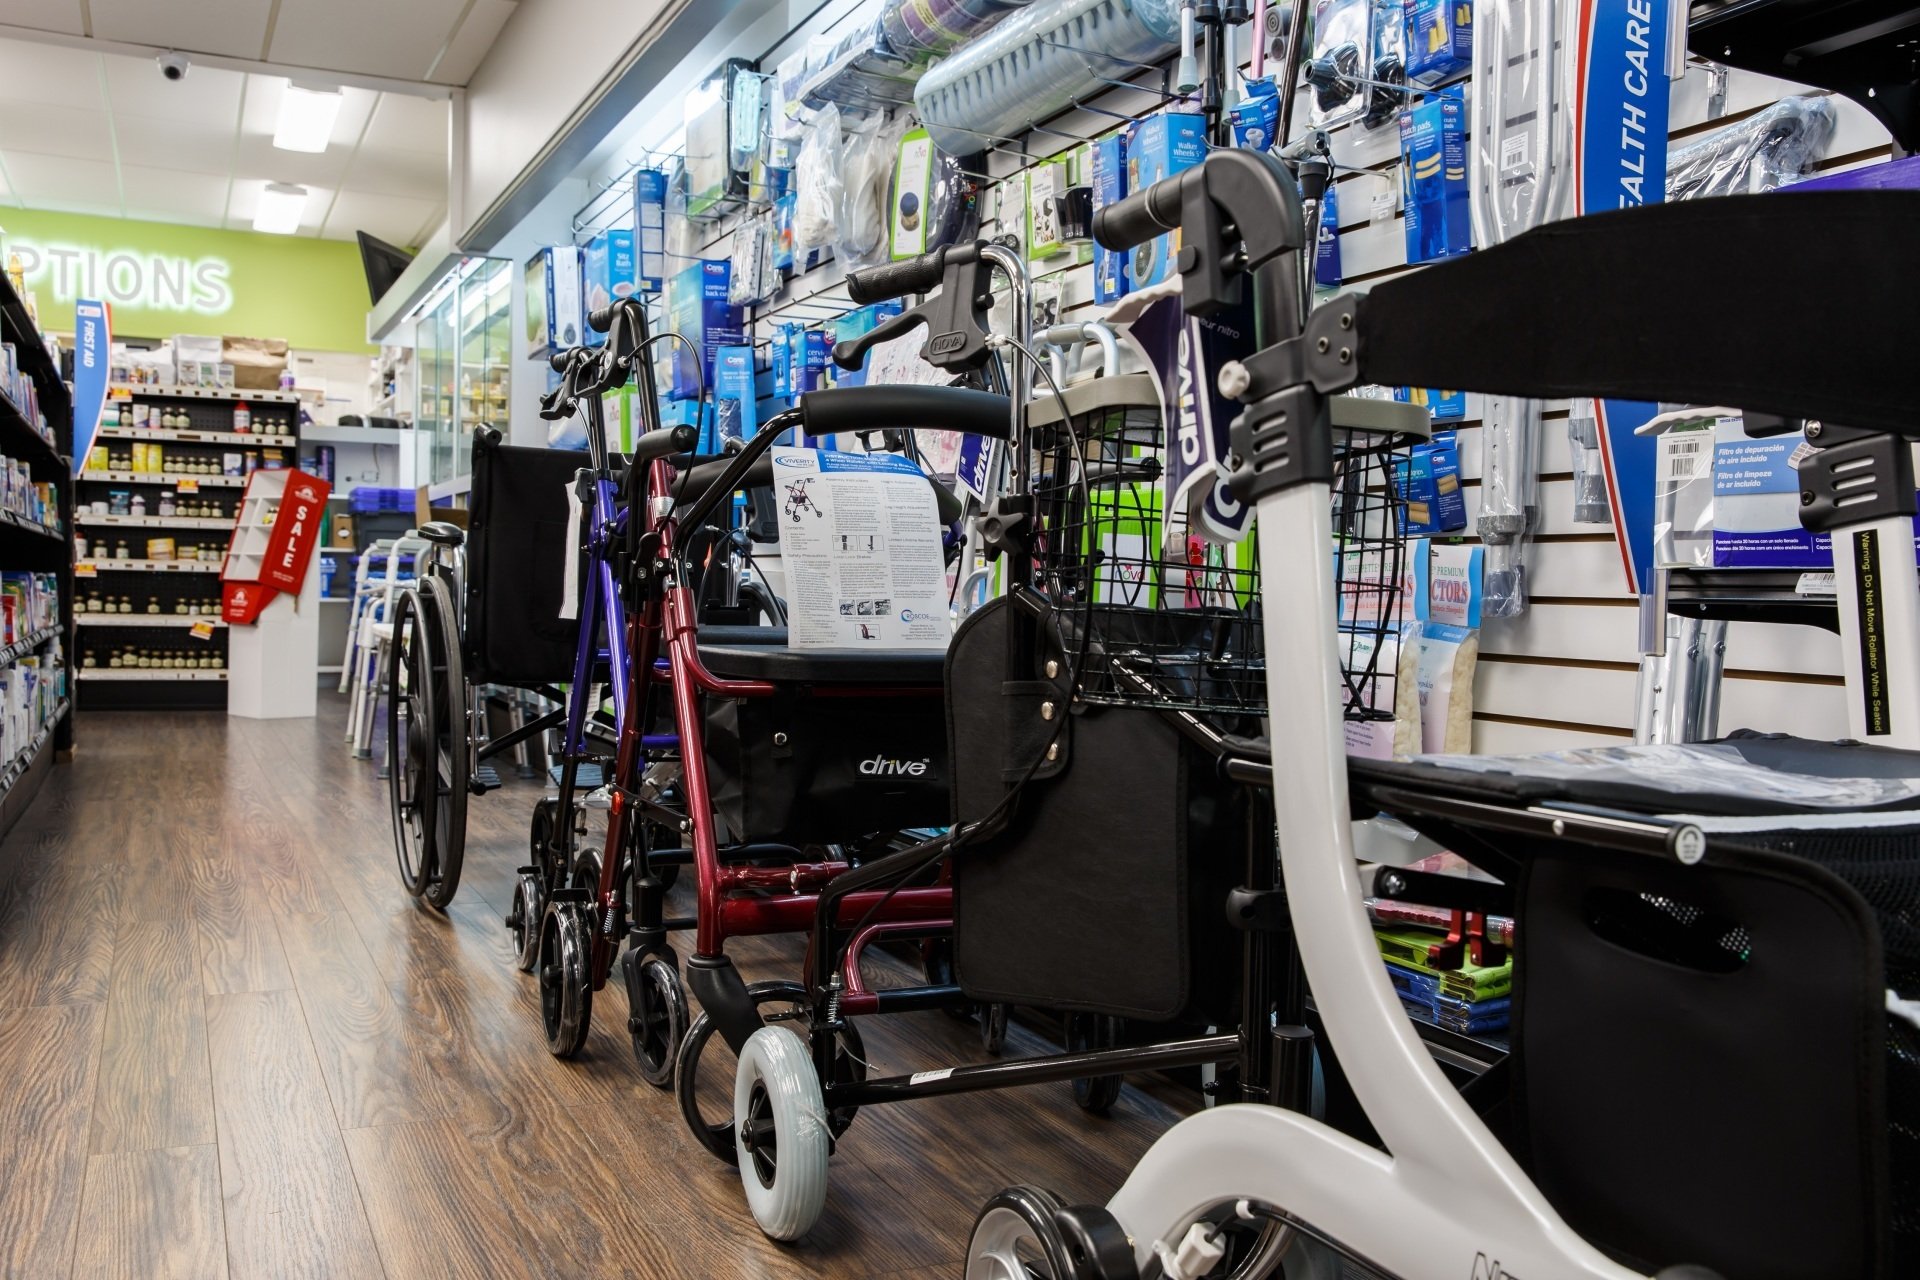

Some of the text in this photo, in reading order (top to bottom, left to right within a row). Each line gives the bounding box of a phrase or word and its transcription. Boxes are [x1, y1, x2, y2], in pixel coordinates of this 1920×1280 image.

[1623, 0, 1650, 97] CARE
[1418, 120, 1431, 132] pads
[1178, 142, 1198, 150] Walker
[10, 245, 226, 309] PTIONS
[83, 320, 95, 368] FIRST AID
[1217, 325, 1240, 339] nitro
[1178, 328, 1200, 466] drive
[1744, 444, 1785, 455] depuración
[282, 506, 308, 568] SALE
[1348, 564, 1378, 574] SHEPETTE
[1437, 566, 1464, 577] PREMIUM
[1865, 575, 1872, 588] Do
[1432, 579, 1468, 604] CTORS
[1868, 636, 1877, 670] Rollator
[1872, 672, 1880, 697] While
[1873, 700, 1882, 732] Seated
[860, 754, 927, 776] drive
